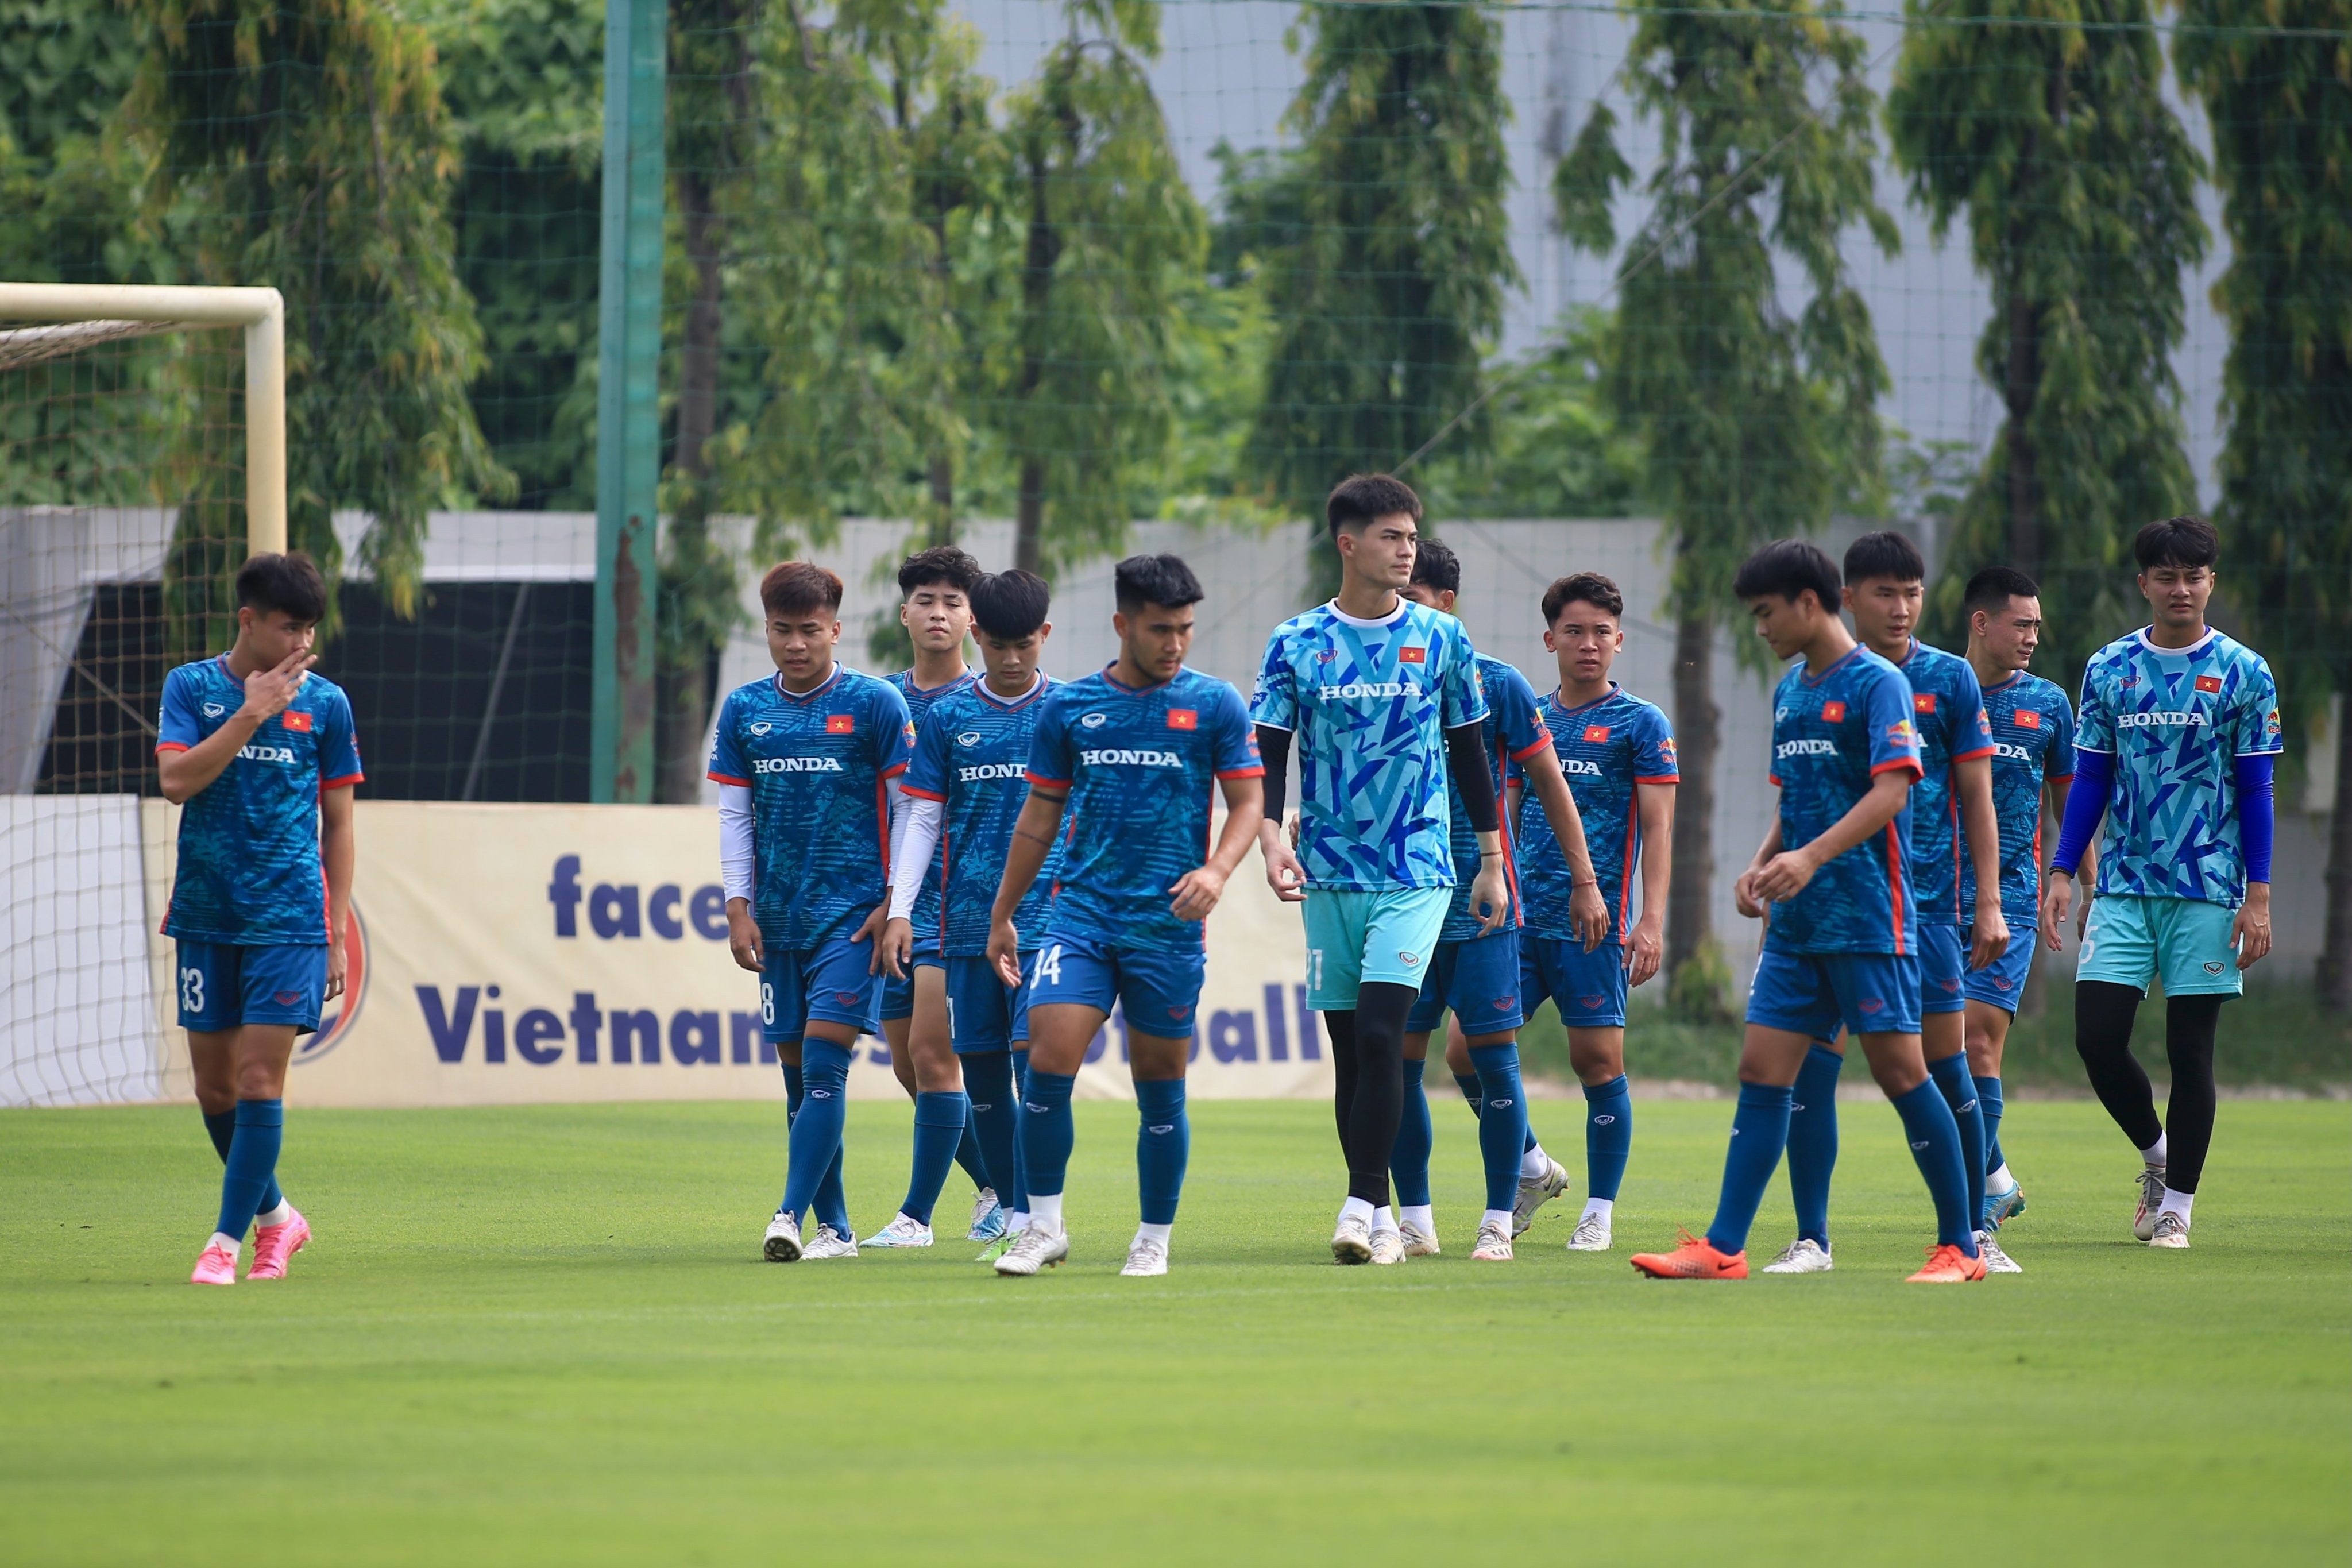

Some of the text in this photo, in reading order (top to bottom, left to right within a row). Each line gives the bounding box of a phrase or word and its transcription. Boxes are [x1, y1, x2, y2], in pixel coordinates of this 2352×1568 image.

[1319, 682, 1423, 700] HONDA
[2117, 712, 2208, 728] HONDA
[235, 745, 296, 764] NDA
[1080, 749, 1183, 767] HONDA
[752, 757, 843, 774] HONDA
